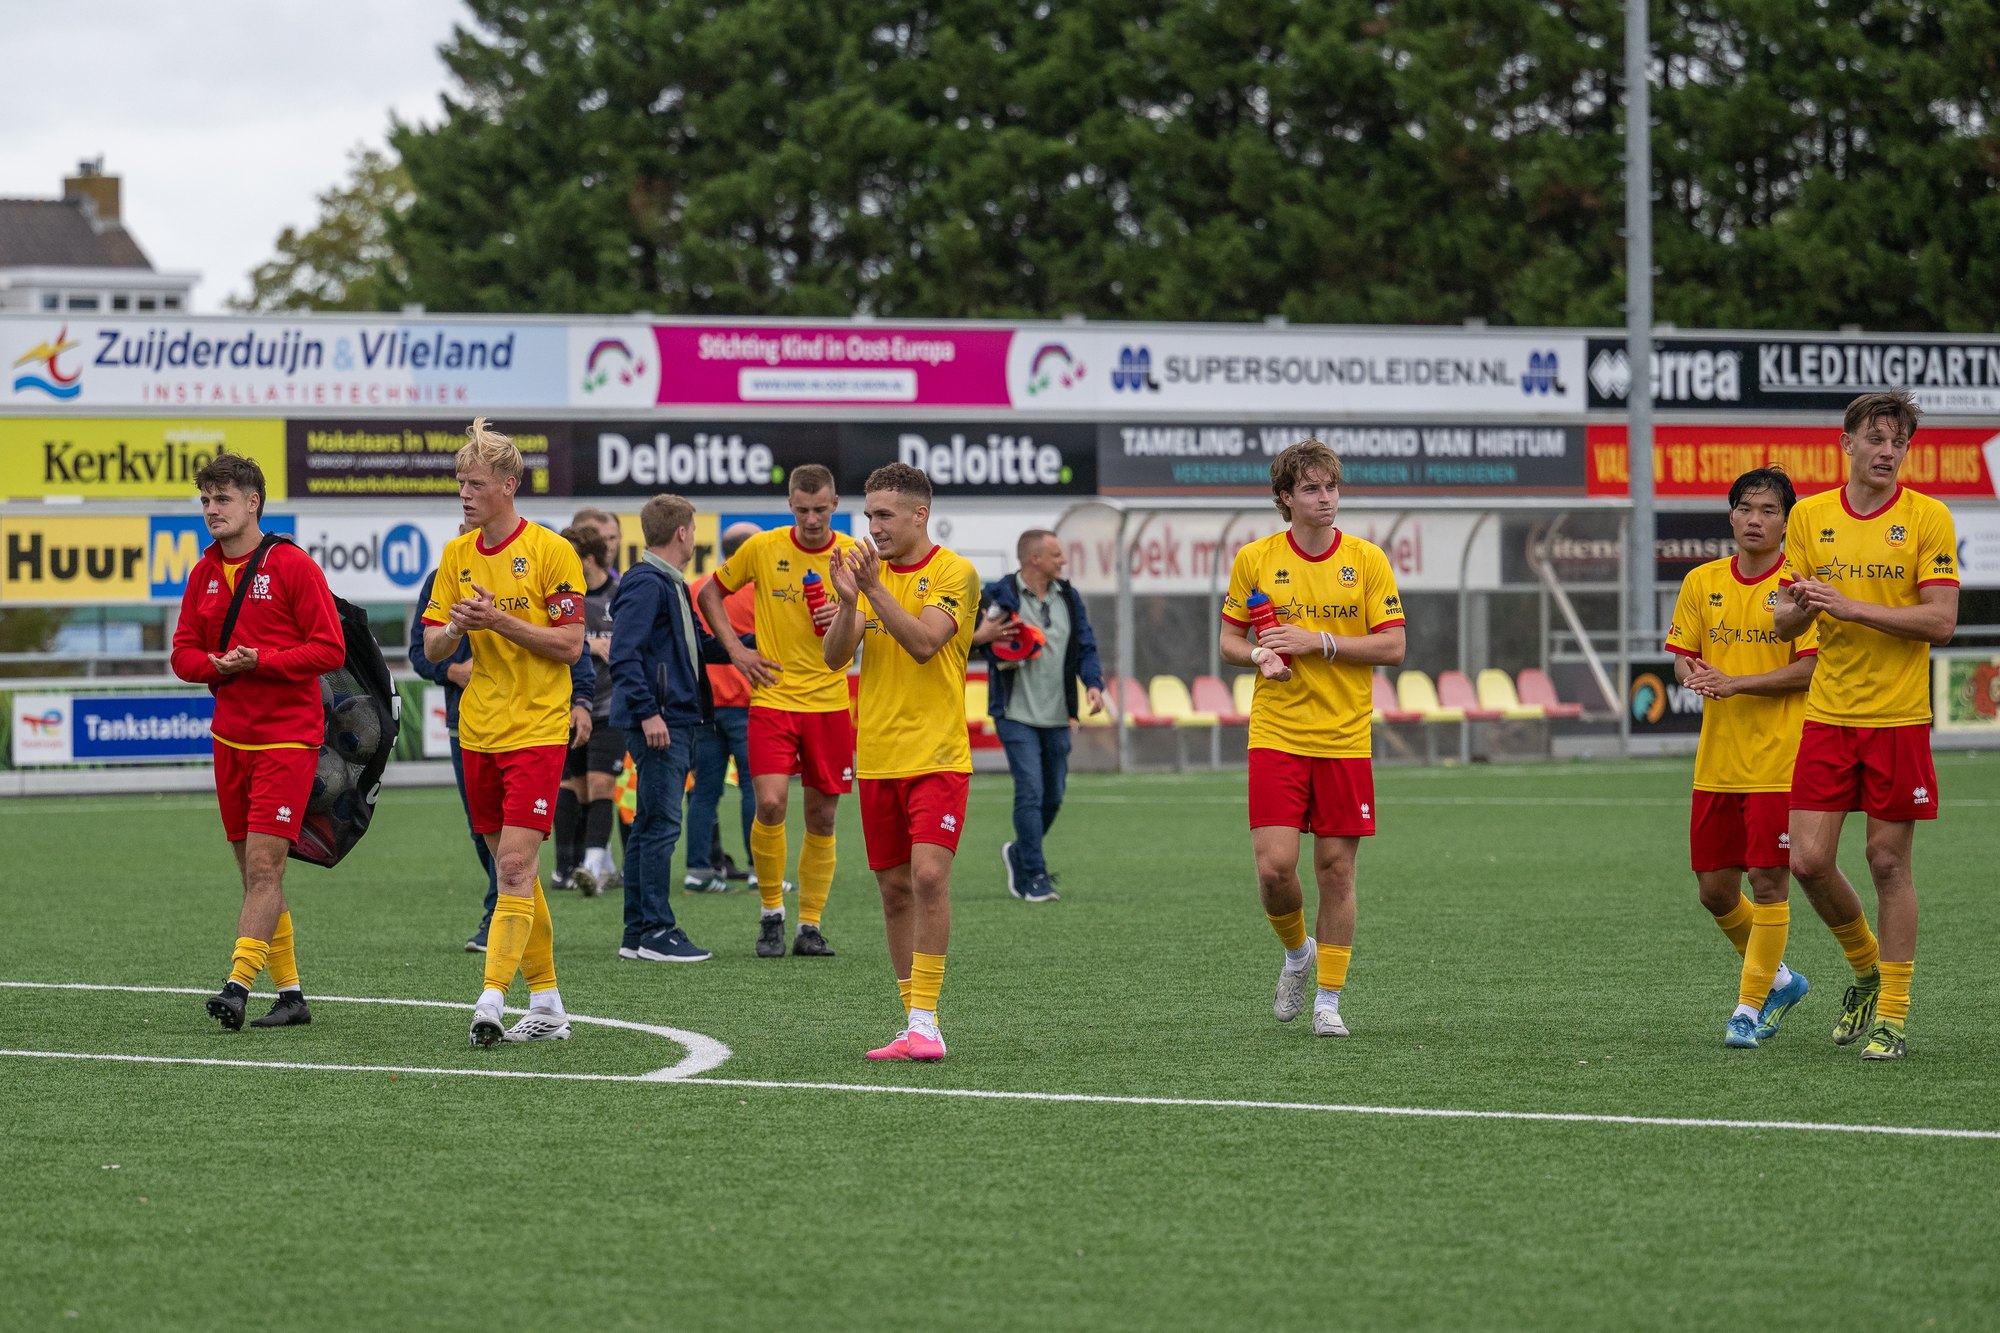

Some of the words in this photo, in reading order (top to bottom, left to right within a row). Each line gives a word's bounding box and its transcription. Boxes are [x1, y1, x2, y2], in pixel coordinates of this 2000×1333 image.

[94, 329, 323, 376] Zuijderduijn
[359, 330, 514, 370] Vlieland
[1164, 355, 1515, 387] SUPERSOUNDLEIDEN.NL
[142, 382, 469, 405] INSTALLATIETECHNIEK
[43, 442, 224, 484] Kerkvlie
[1866, 564, 1905, 579] STAR
[501, 597, 530, 611] STAR
[1322, 605, 1358, 618] STAR
[1746, 629, 1779, 645] STAR
